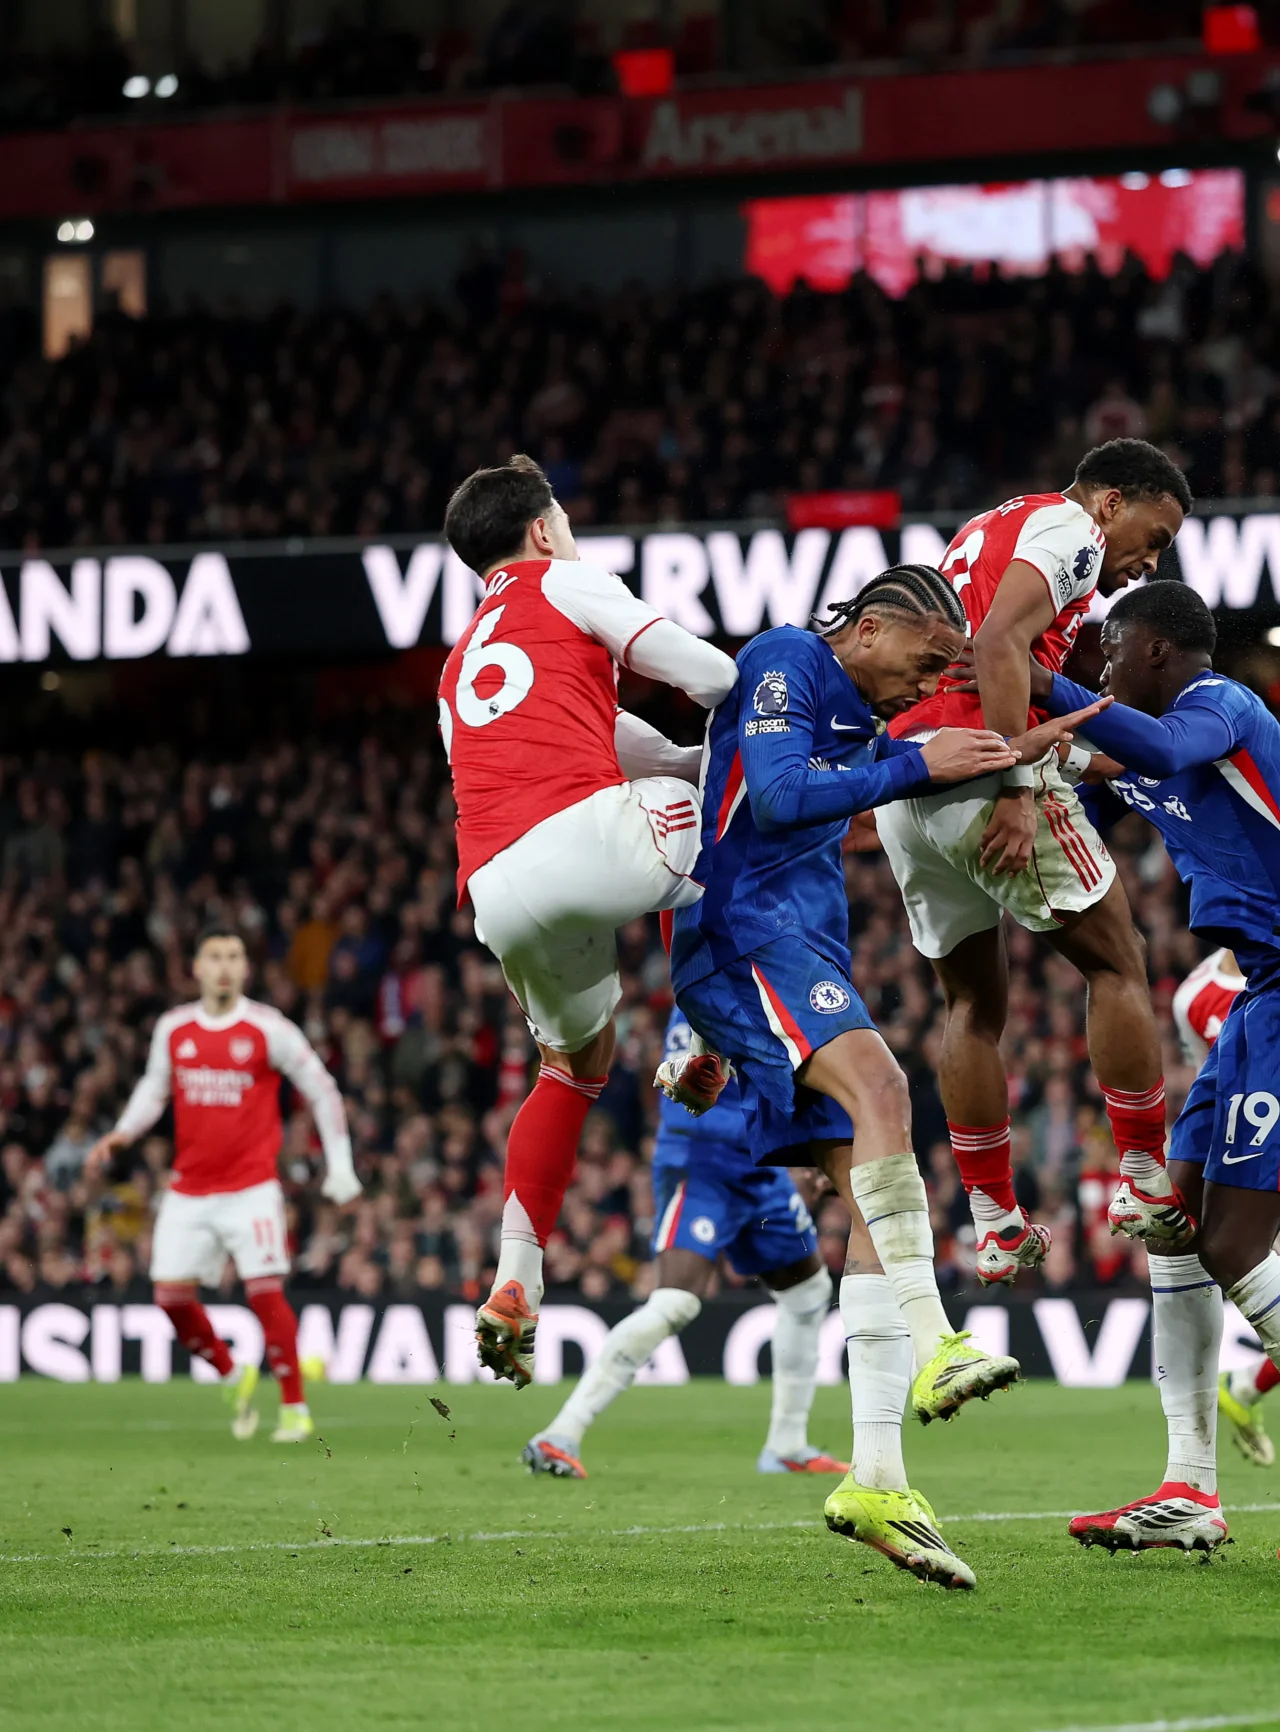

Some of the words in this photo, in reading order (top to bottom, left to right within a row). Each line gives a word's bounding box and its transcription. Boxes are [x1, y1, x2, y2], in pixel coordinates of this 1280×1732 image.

[646, 86, 865, 168] Arsenal
[437, 603, 536, 768] 6
[745, 719, 758, 730] No
[759, 718, 786, 727] room
[745, 727, 758, 737] for
[759, 725, 791, 734] racism
[1225, 1091, 1280, 1147] 19
[251, 1216, 275, 1247] 11
